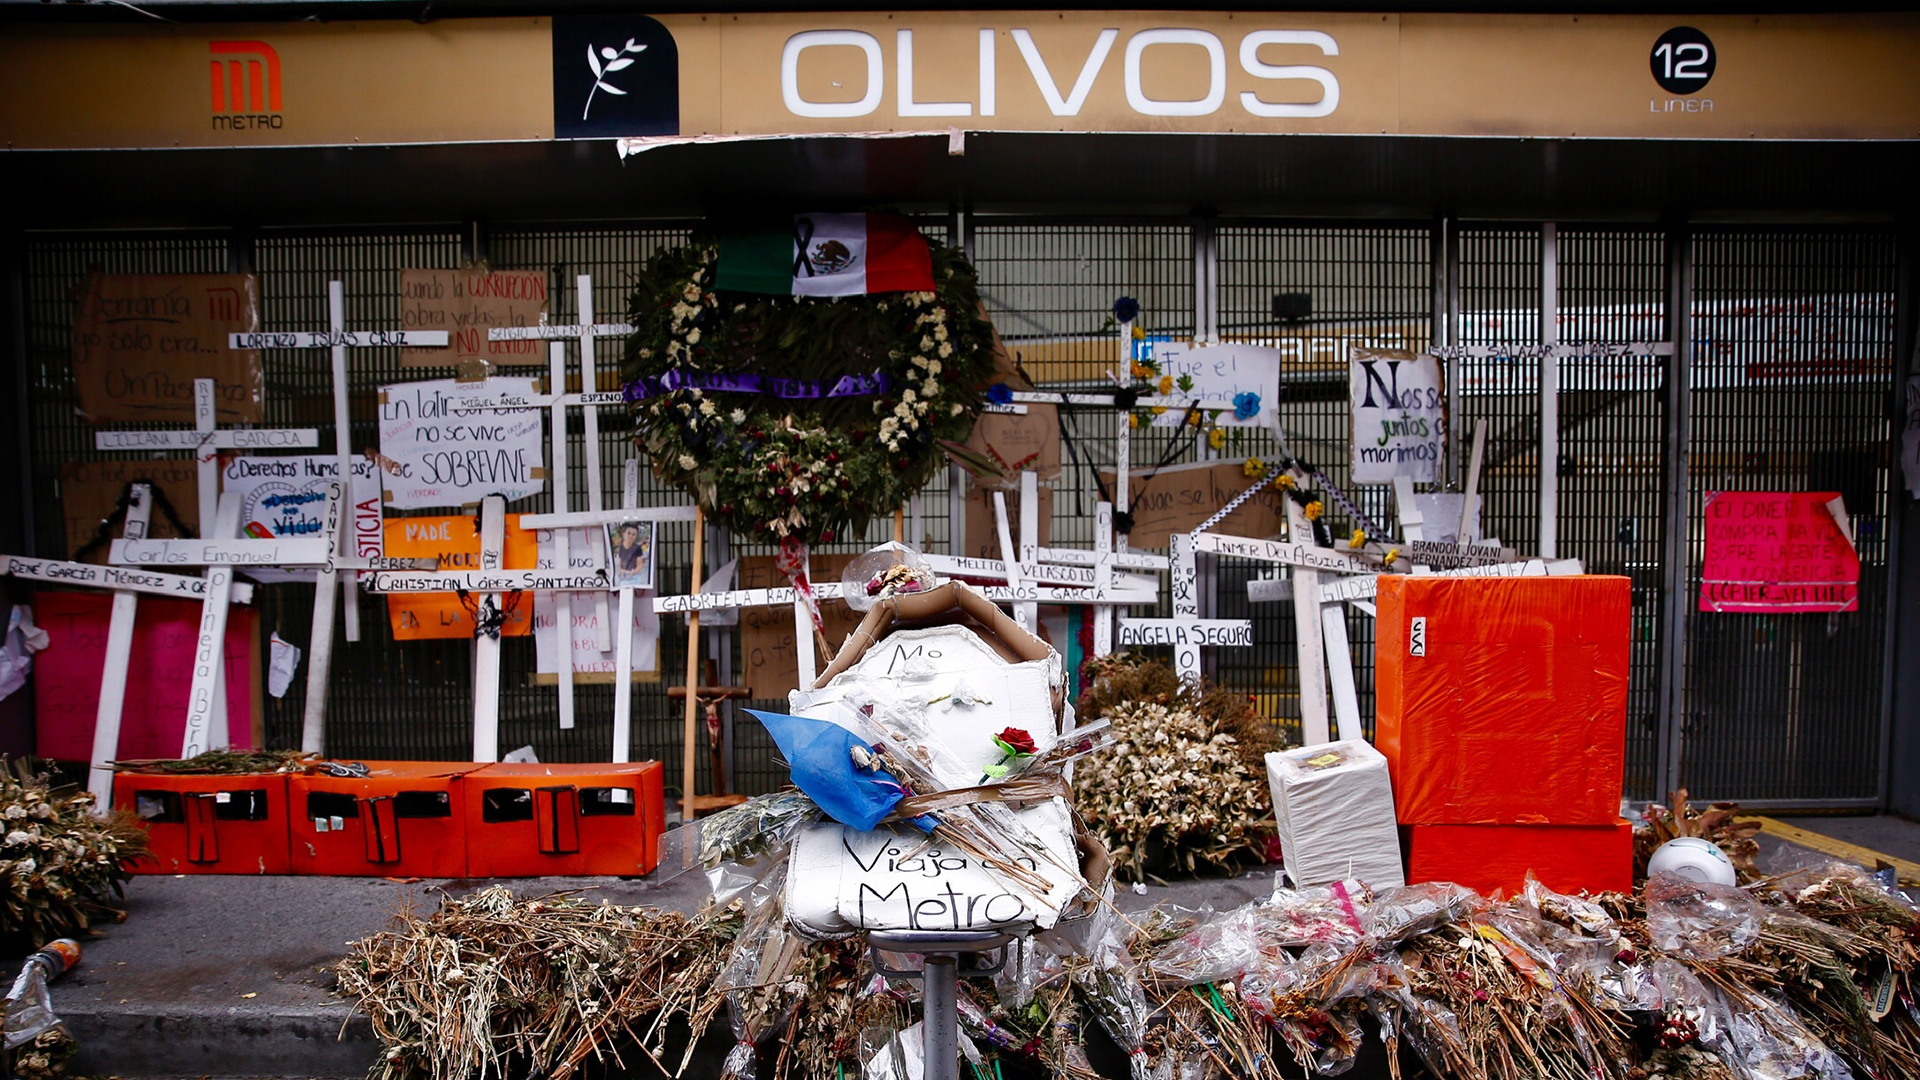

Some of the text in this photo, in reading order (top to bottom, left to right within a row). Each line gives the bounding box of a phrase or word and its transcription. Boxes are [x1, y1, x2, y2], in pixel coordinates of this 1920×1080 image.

[1654, 42, 1710, 79] 12
[780, 28, 1341, 119] OLIVOS
[1650, 98, 1715, 113] LINEA
[212, 114, 283, 130] METRO
[236, 331, 408, 347] LORENZO ISLAS CRUZ
[460, 399, 496, 407] MIGUEL
[580, 394, 626, 404] ESPINO
[1360, 442, 1438, 464] morimos
[304, 458, 376, 479] Humaos?
[405, 521, 452, 542] NADIE
[122, 538, 278, 563] Carlos Emanuel
[1412, 535, 1501, 557] BRANDON JOVANI
[438, 552, 480, 568] MORI
[1411, 553, 1472, 568] HERNANDEZ
[662, 592, 751, 611] GABRIELA
[766, 584, 838, 603] RAMREZ
[1175, 604, 1198, 615] PAZ
[843, 837, 968, 878] Viaja
[858, 880, 1026, 931] Metro
